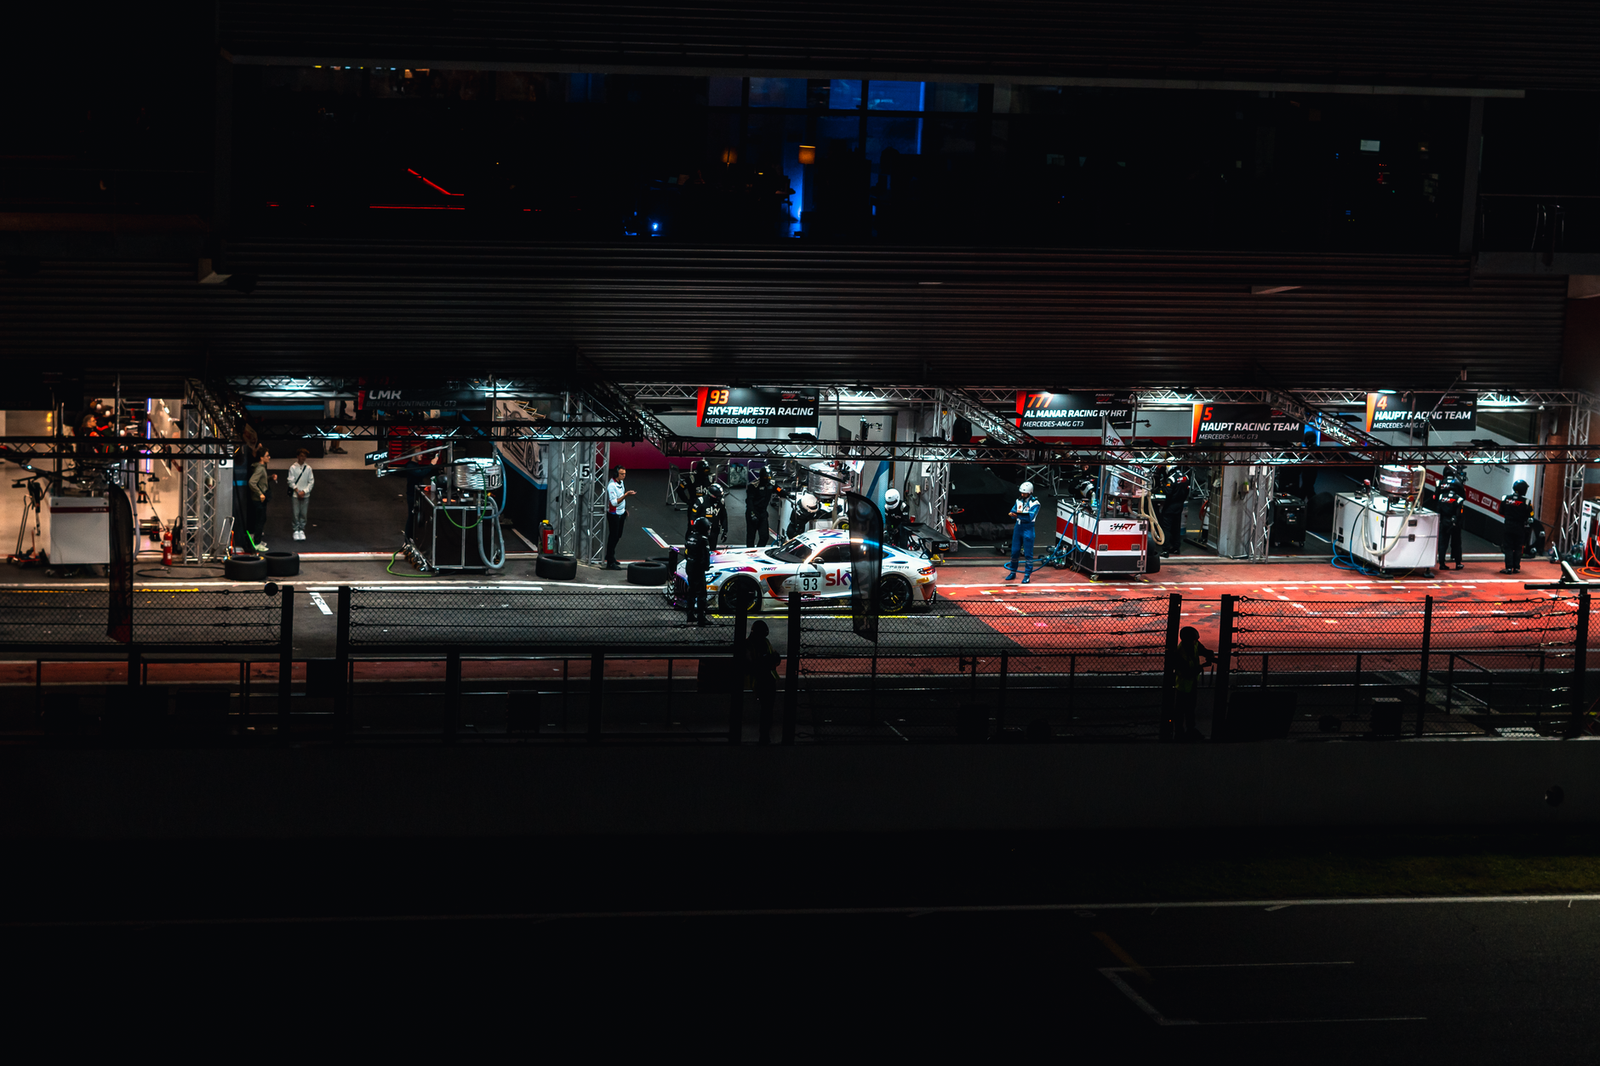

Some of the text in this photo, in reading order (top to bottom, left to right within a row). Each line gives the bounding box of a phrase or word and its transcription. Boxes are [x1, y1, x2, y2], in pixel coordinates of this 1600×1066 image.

[709, 390, 730, 405] 93
[1027, 394, 1054, 408] 777
[1376, 396, 1388, 410] 4
[706, 406, 814, 416] SKY-TEMPESTA RACING
[1024, 410, 1040, 418] AL
[1039, 410, 1069, 418] MANAR
[1069, 410, 1100, 418] RACING
[1203, 407, 1213, 420] 5
[1374, 411, 1407, 421] HAUPT
[1444, 411, 1472, 420] TEAM
[1200, 422, 1300, 432] HAUPT RACING TEAM
[582, 465, 590, 477] 5
[705, 505, 721, 517] sky
[803, 578, 818, 591] 93
